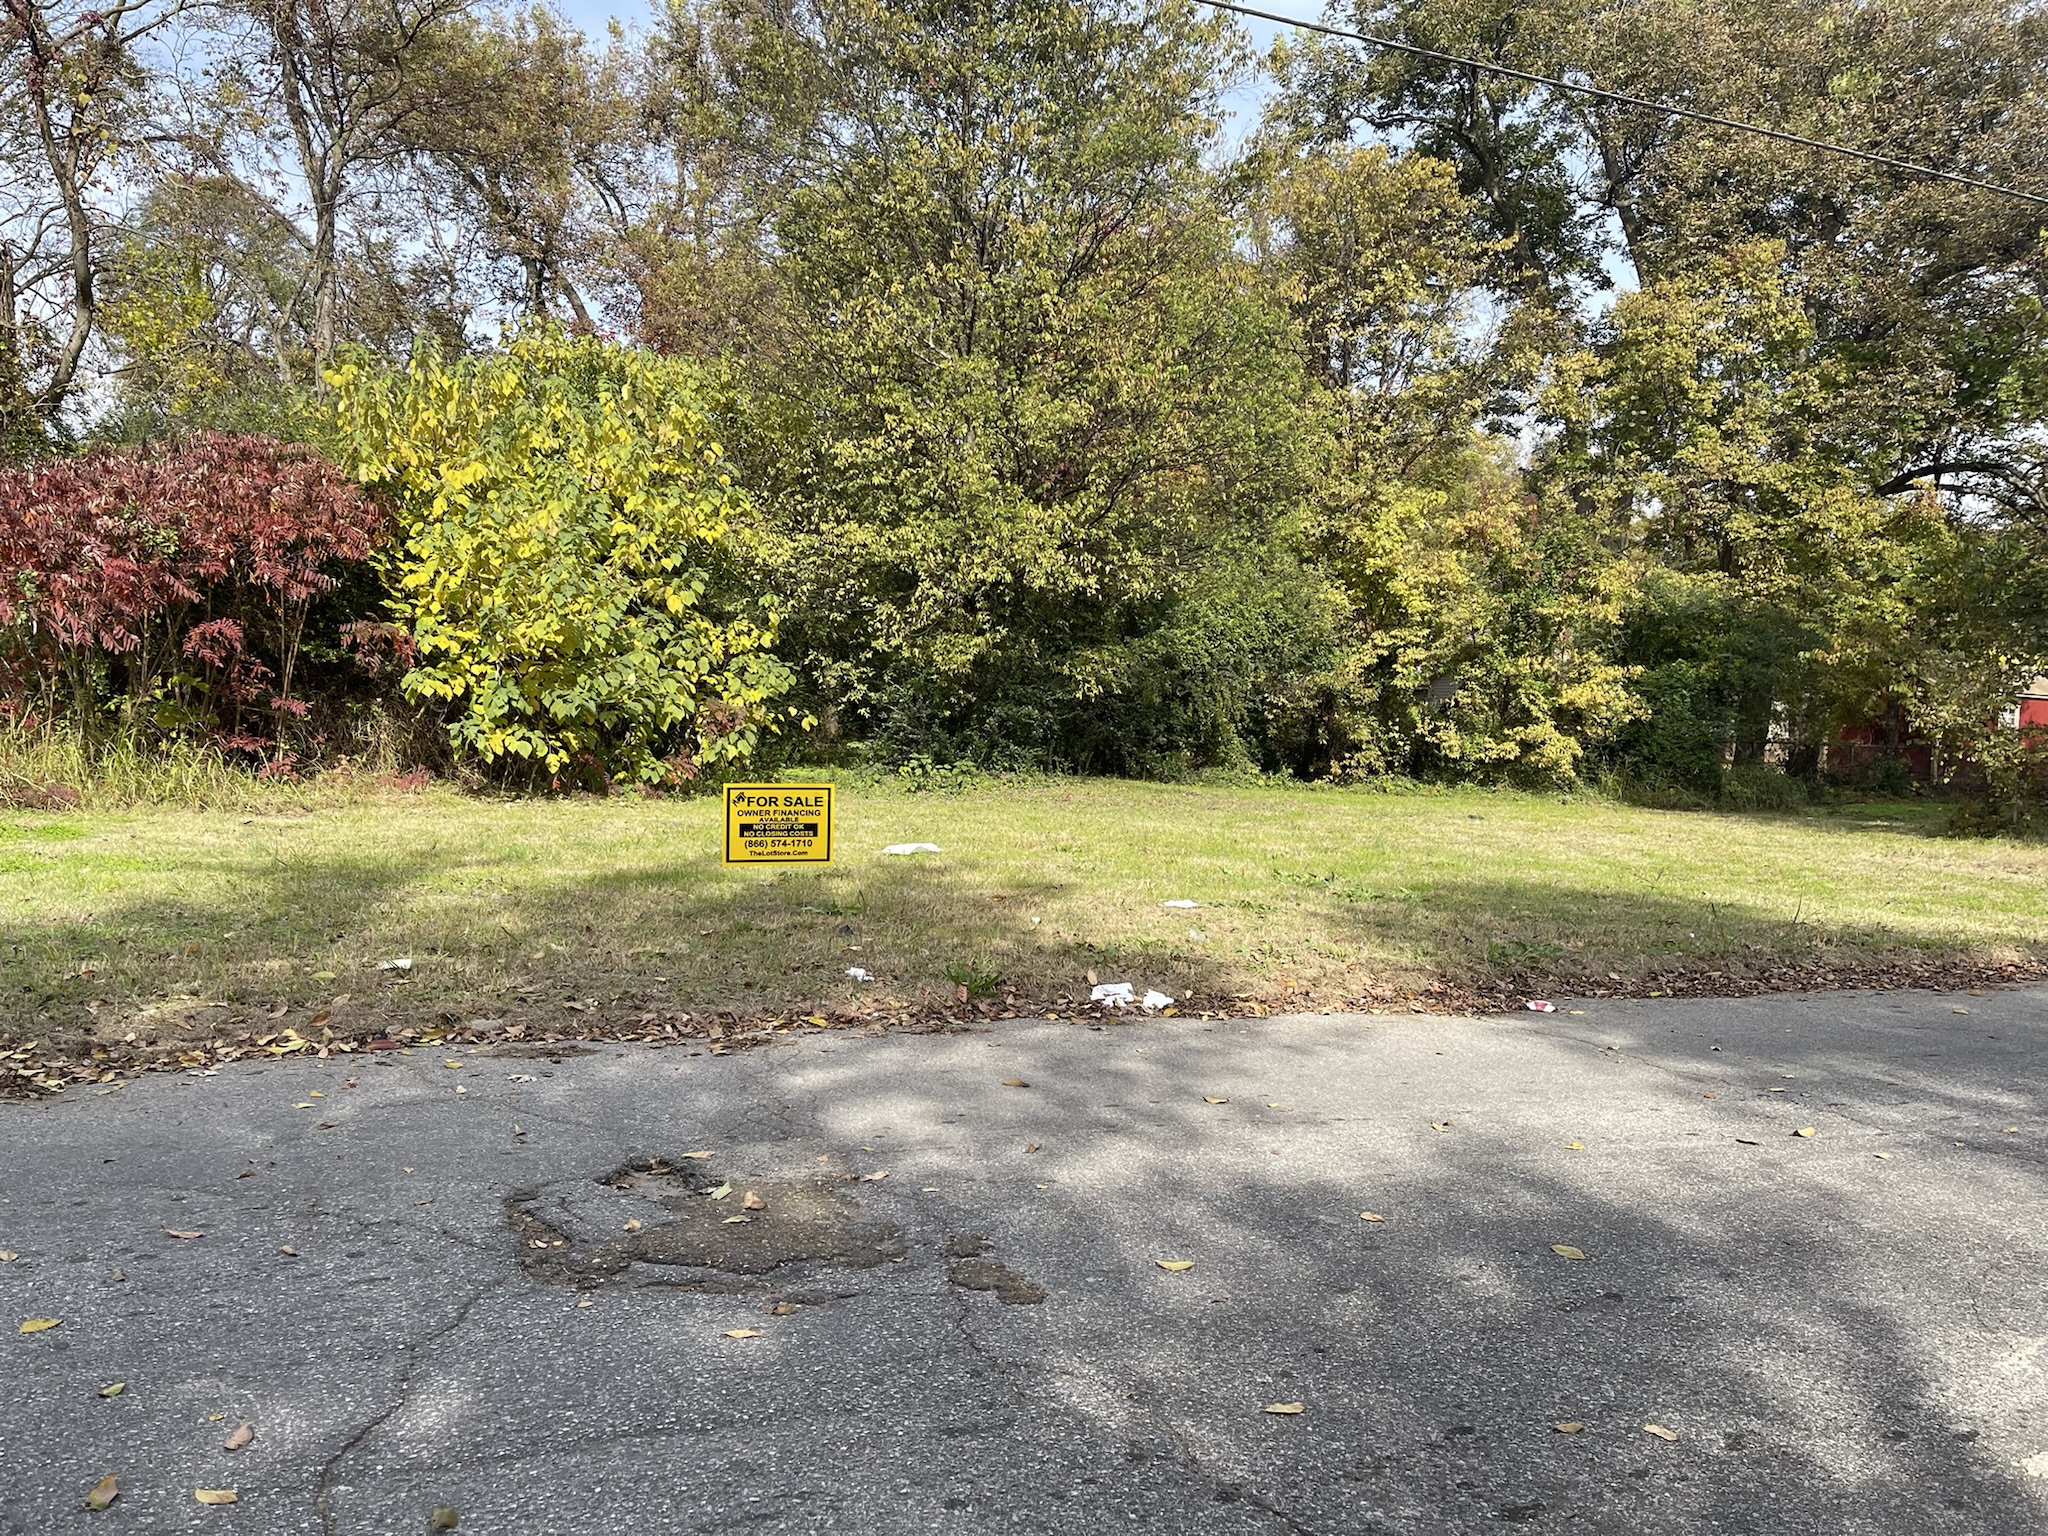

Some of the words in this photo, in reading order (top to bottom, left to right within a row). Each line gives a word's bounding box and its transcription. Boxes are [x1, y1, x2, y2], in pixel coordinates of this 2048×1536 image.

[747, 796, 778, 807] FOR
[784, 796, 824, 807] SALE
[744, 840, 768, 849] (866)
